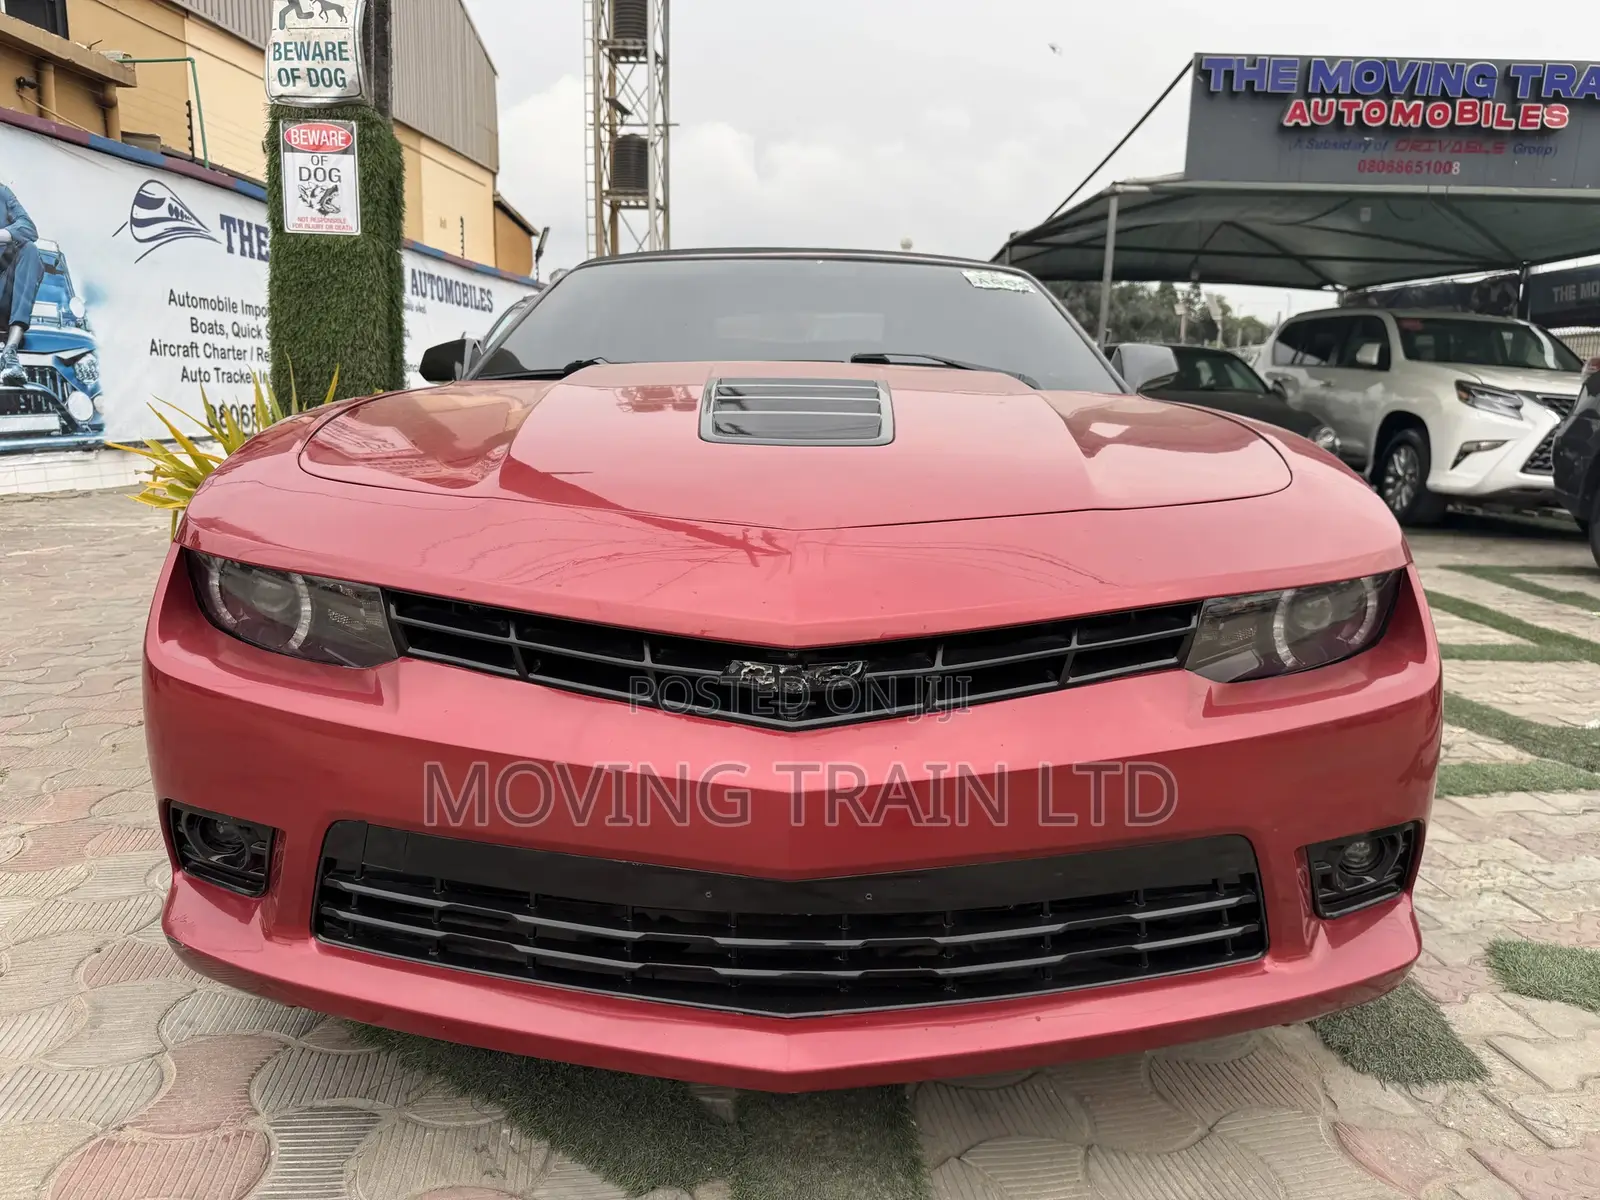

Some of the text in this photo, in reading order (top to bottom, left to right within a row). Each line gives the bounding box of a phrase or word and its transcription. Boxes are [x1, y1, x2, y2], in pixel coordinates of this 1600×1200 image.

[272, 40, 350, 61] BEWARE
[277, 67, 347, 88] OF DOG
[1202, 56, 1600, 100] THE MOVING TRA
[1283, 99, 1569, 130] AUTOMOBILES
[290, 129, 346, 147] BEWARE
[1374, 139, 1389, 151] of
[311, 155, 328, 166] OF
[1357, 159, 1461, 175] 08068651008
[298, 166, 341, 183] DOG
[220, 213, 269, 262] THE
[168, 288, 238, 314] Automobile
[411, 268, 493, 313] AUTOMOBILES
[1552, 284, 1577, 303] THE
[190, 316, 228, 339] Boats,
[231, 321, 263, 340] Quick
[149, 338, 200, 358] Aircraft
[203, 342, 248, 361] Charter
[181, 365, 211, 383] Auto
